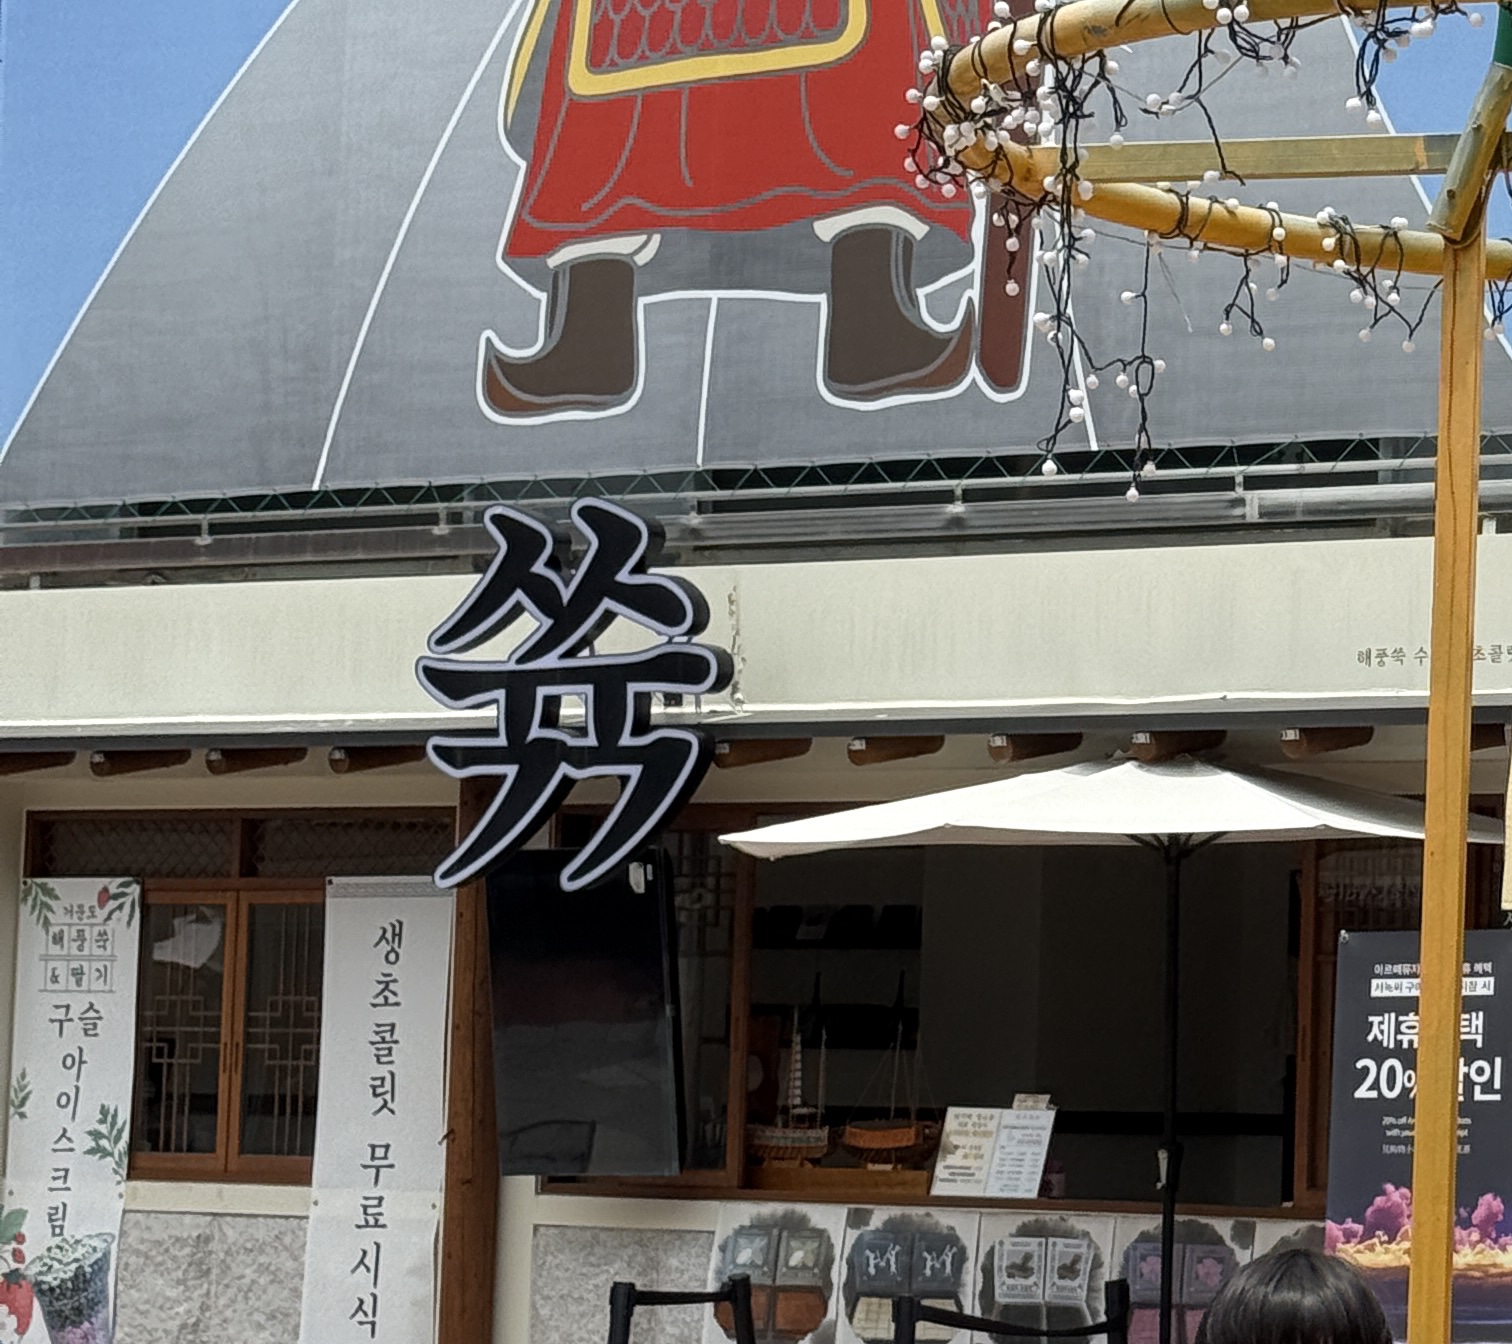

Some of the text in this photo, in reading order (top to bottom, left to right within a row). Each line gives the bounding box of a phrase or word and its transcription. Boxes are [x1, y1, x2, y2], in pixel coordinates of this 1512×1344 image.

[416, 498, 728, 891] 쑥
[1357, 647, 1406, 668] 해풍쑥
[50, 964, 108, 987] & 딸기
[51, 928, 110, 953] 해풍쑥
[368, 918, 404, 1116] 생초콜릿
[46, 1001, 104, 1238] 구슬 아이스크림
